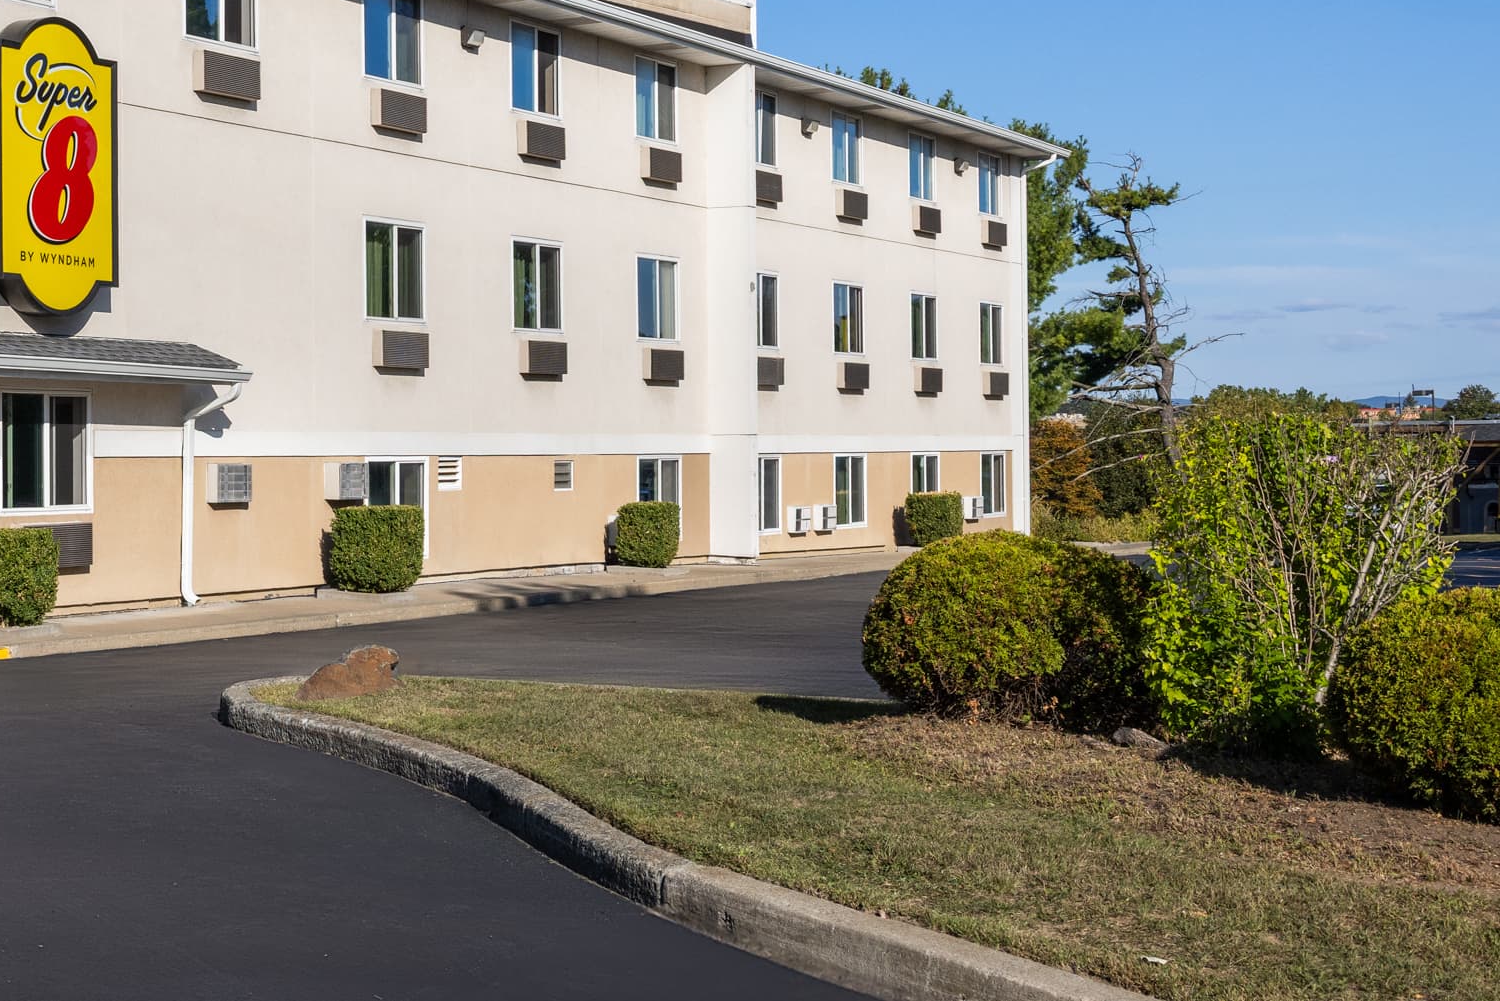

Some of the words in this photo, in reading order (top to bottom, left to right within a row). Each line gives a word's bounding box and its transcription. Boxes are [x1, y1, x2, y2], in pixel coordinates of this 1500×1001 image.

[16, 53, 97, 132] Super
[27, 116, 98, 245] 8
[20, 250, 35, 262] BY
[40, 252, 95, 267] WYNDHAM
